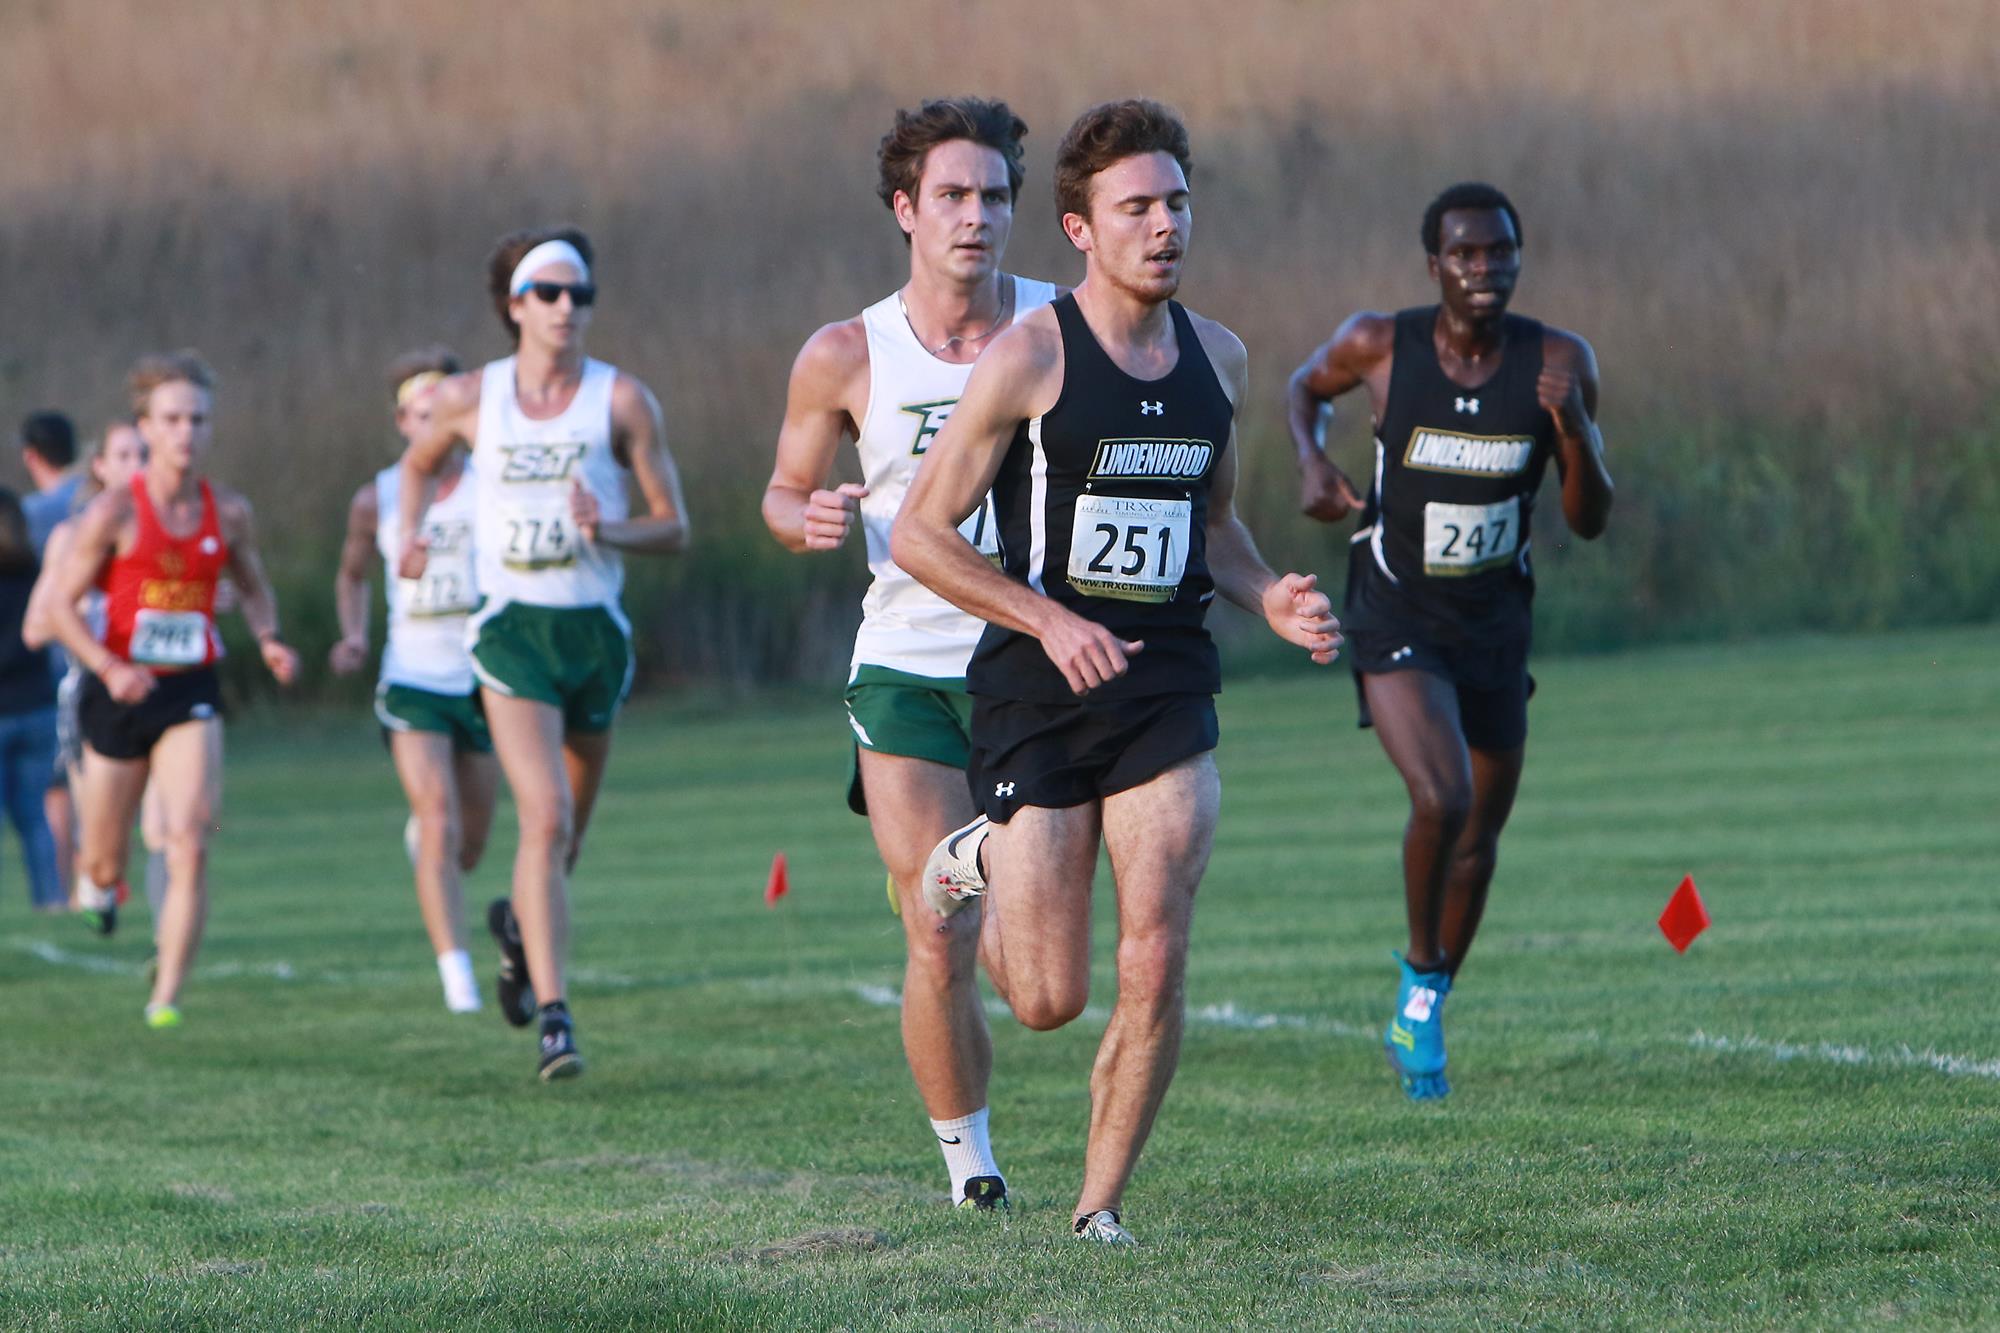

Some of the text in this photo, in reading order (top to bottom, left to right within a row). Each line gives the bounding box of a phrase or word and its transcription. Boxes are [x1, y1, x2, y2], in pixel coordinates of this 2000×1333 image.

[1095, 443, 1211, 477] LINDENWOOD
[1408, 431, 1532, 473] LINDENWOOD
[1112, 500, 1162, 513] TRXC
[506, 517, 564, 554] 274
[1088, 523, 1171, 577] 251
[1441, 518, 1507, 557] 247
